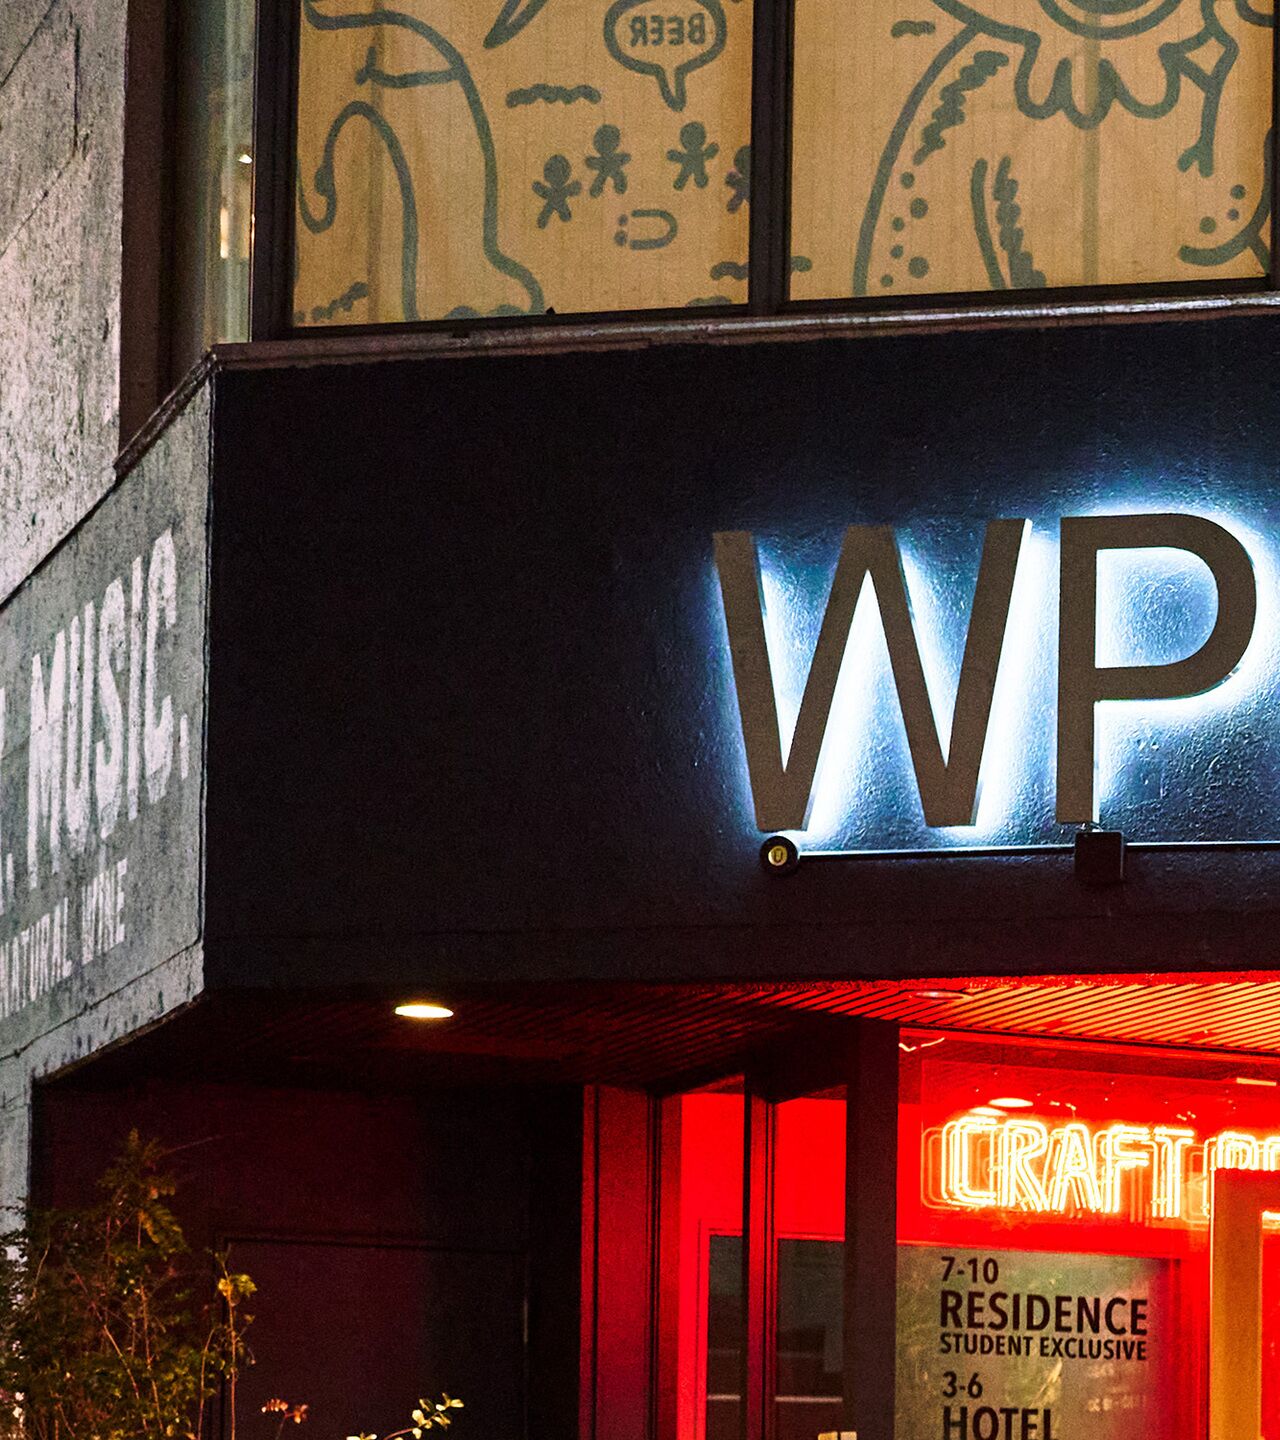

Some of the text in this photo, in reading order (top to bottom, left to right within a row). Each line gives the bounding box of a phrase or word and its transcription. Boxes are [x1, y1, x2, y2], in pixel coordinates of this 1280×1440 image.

[82, 857, 127, 967] WINE
[941, 1116, 1195, 1219] CRAFT
[940, 1256, 999, 1284] 7-10
[939, 1290, 1148, 1336] RESIDENCE
[939, 1332, 1147, 1361] STUDENT EXCLUSIVE
[942, 1371, 983, 1399] 3-6
